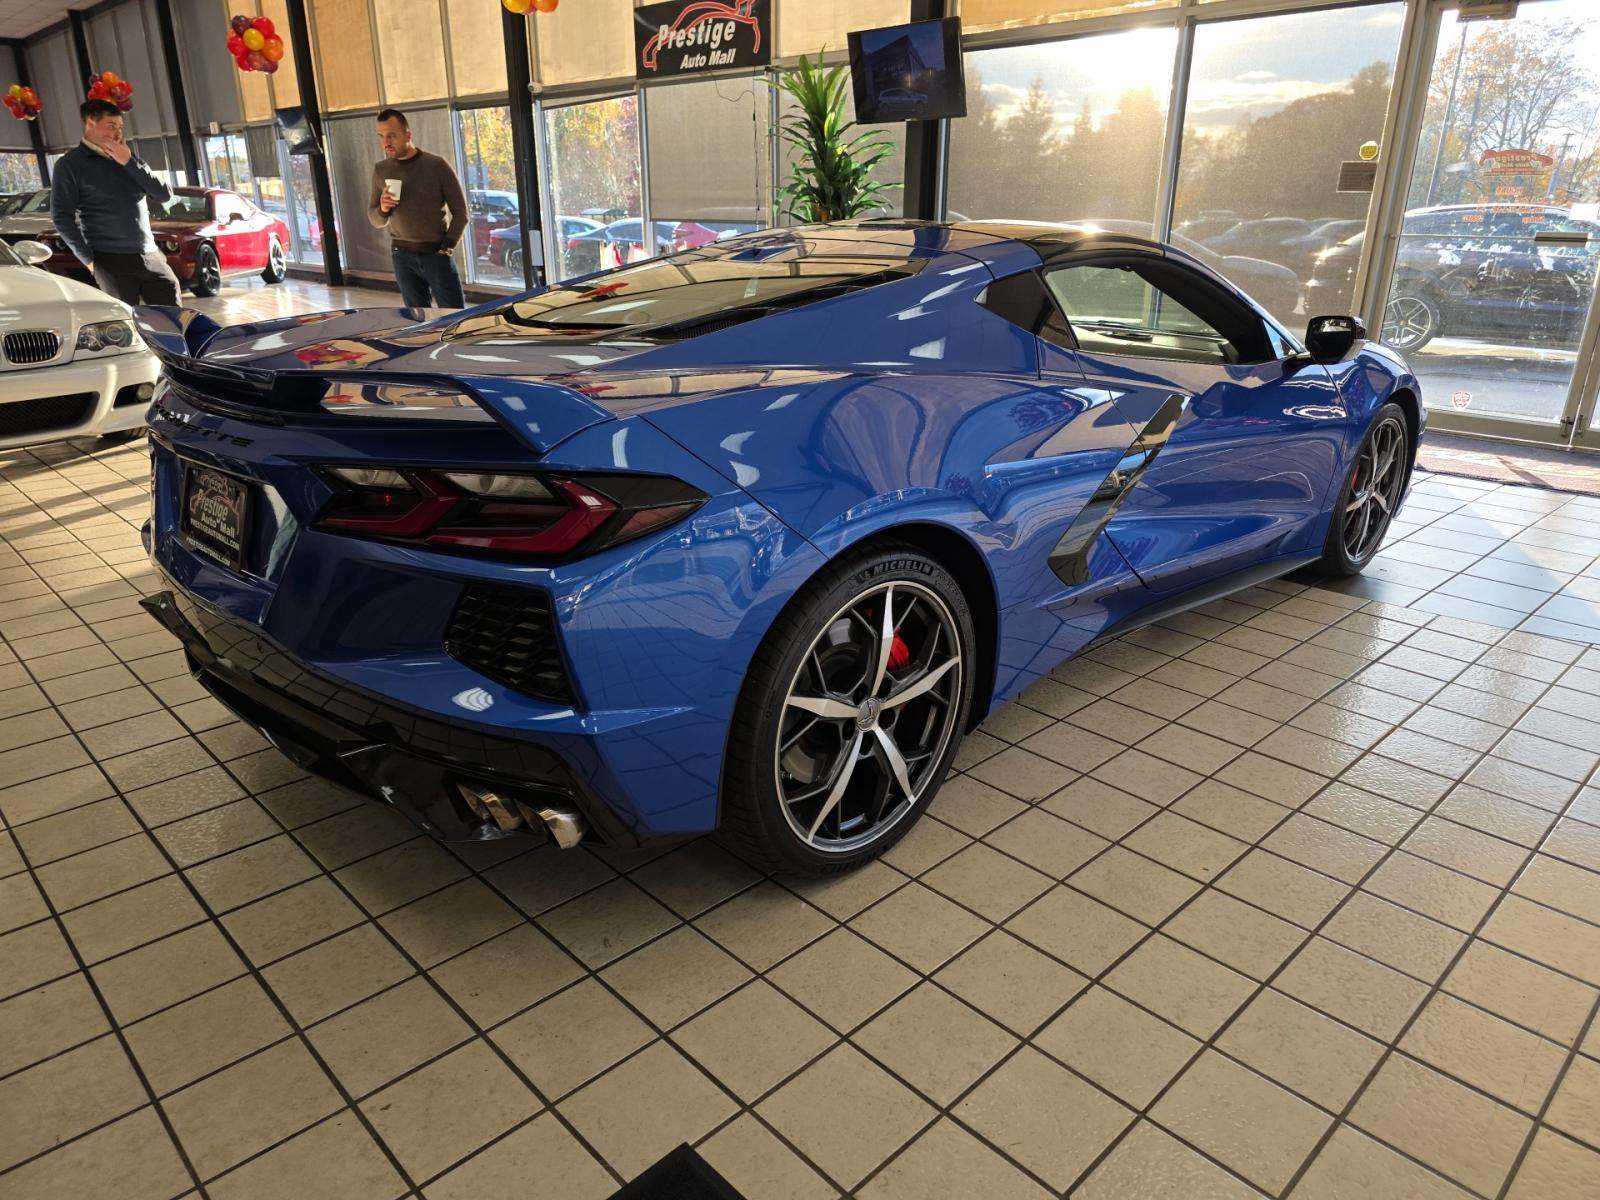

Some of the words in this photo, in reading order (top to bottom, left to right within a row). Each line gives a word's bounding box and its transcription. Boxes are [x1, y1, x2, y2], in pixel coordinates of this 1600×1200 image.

[656, 18, 736, 50] Prestige
[680, 53, 706, 69] Auto
[708, 48, 737, 66] Mall
[201, 512, 217, 528] Auto
[220, 520, 235, 539] Mall
[873, 560, 932, 575] MICHELIN
